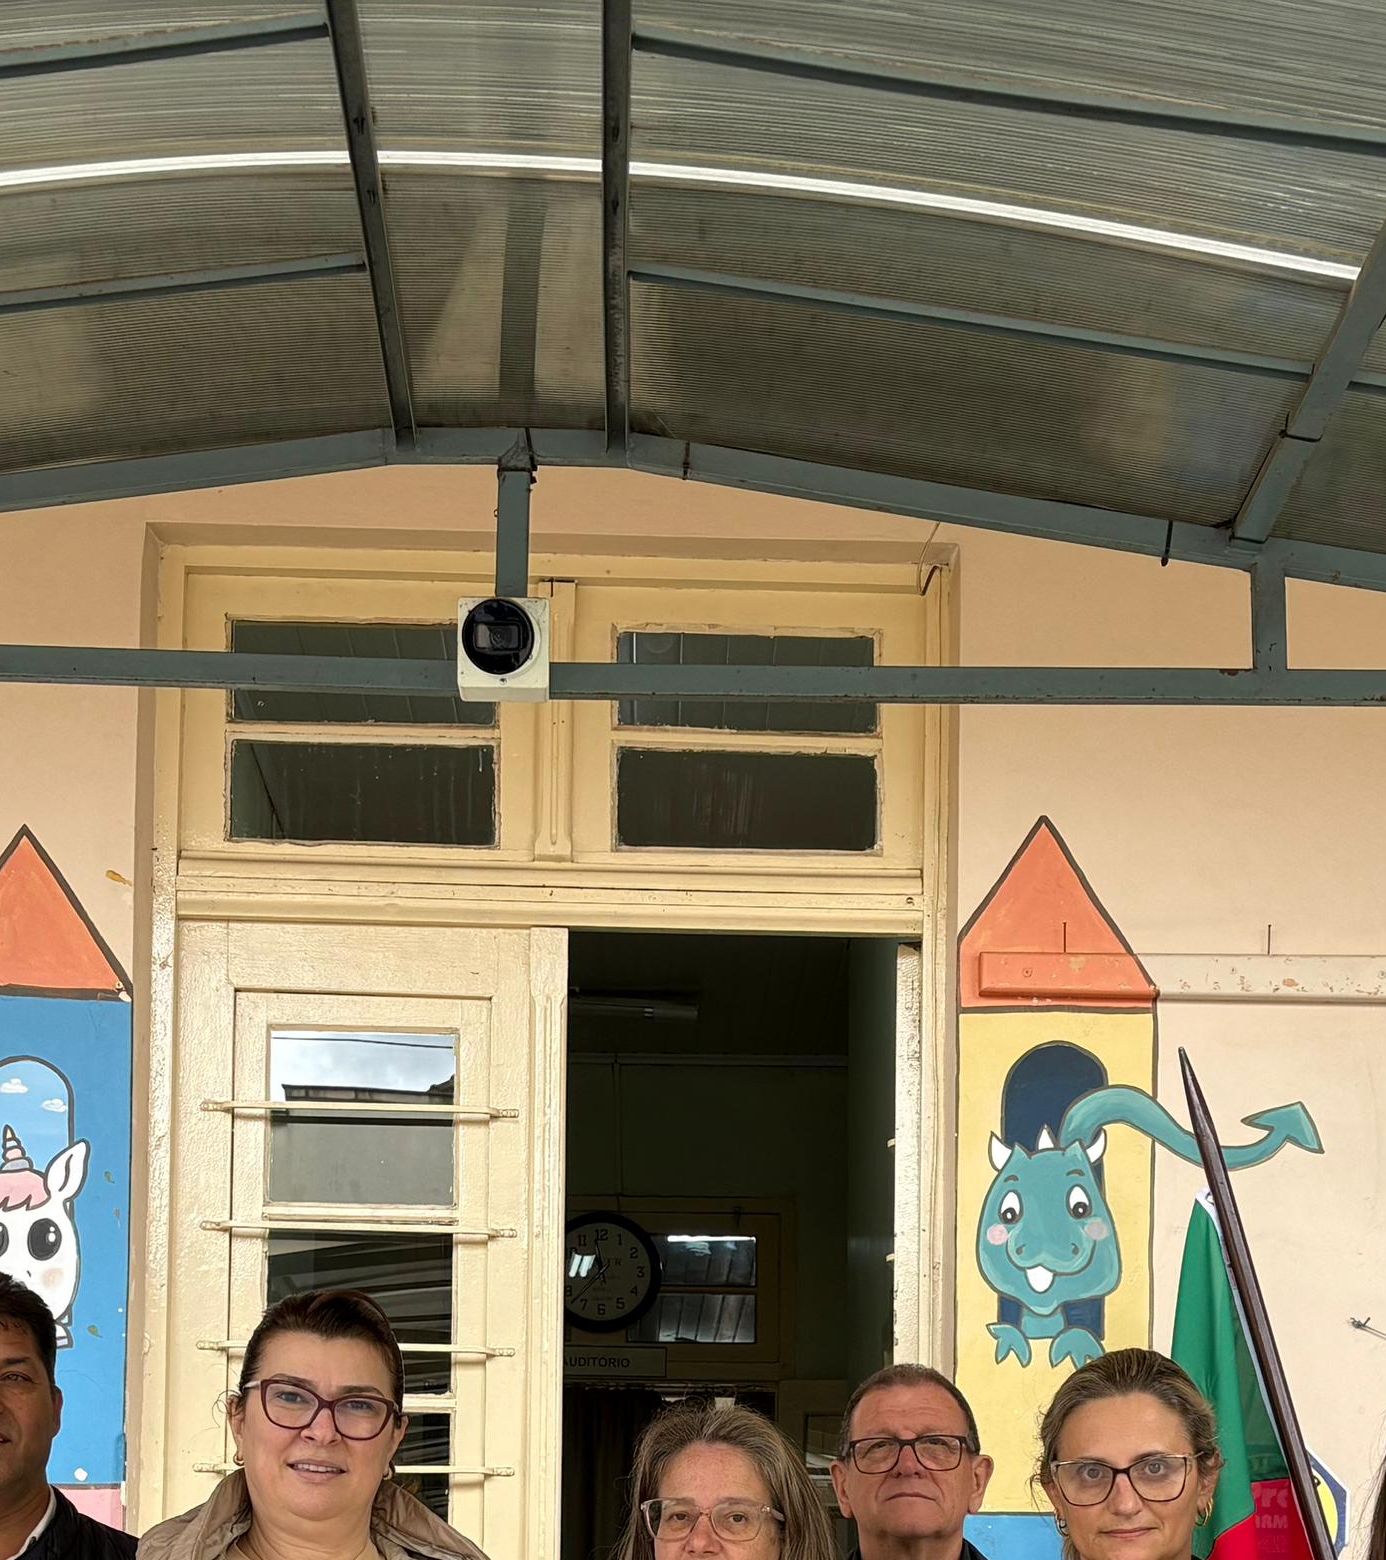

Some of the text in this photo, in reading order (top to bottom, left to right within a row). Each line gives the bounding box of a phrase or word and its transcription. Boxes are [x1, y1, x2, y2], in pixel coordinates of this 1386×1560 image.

[578, 1235, 587, 1246] 11
[594, 1229, 608, 1242] 12
[618, 1234, 623, 1245] 1
[630, 1247, 638, 1259] 2
[637, 1266, 645, 1278] 3
[631, 1286, 638, 1296] 4
[580, 1299, 588, 1310] 7
[616, 1297, 625, 1309] 5
[598, 1304, 606, 1315] 6
